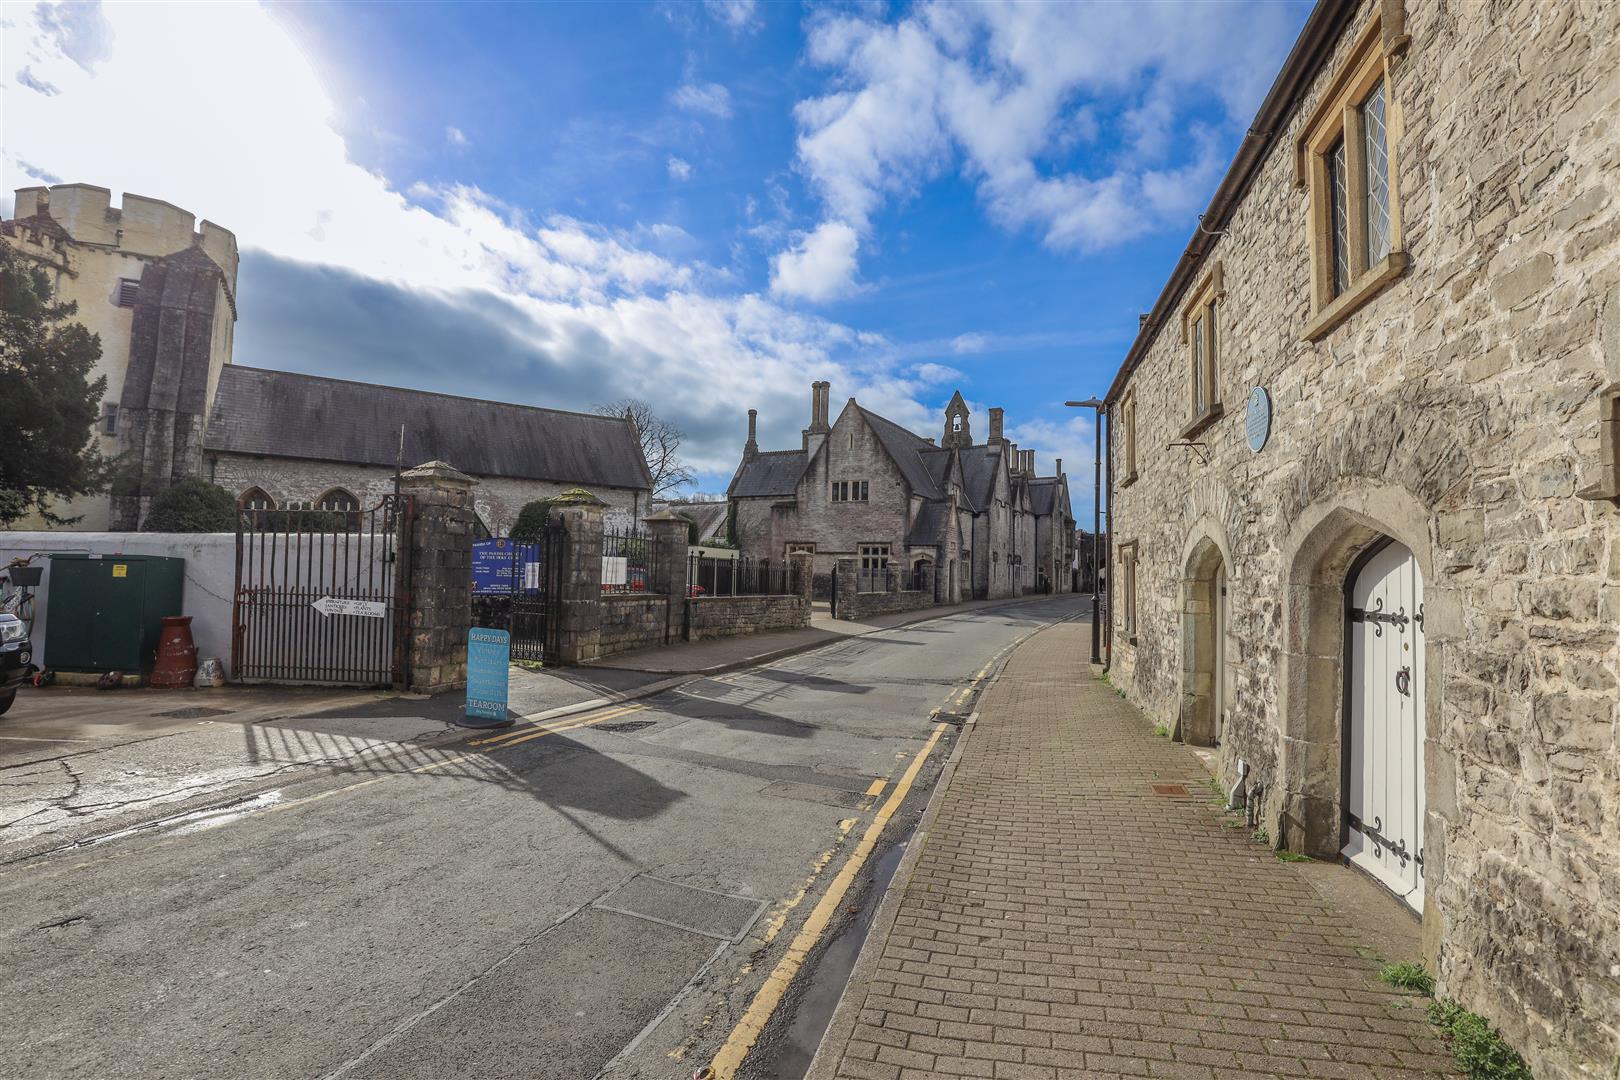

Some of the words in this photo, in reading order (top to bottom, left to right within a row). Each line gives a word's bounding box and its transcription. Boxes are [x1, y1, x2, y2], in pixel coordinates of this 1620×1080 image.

[471, 633, 491, 642] HAPPY
[492, 635, 508, 644] DAYS
[469, 699, 506, 712] TEAROOM
